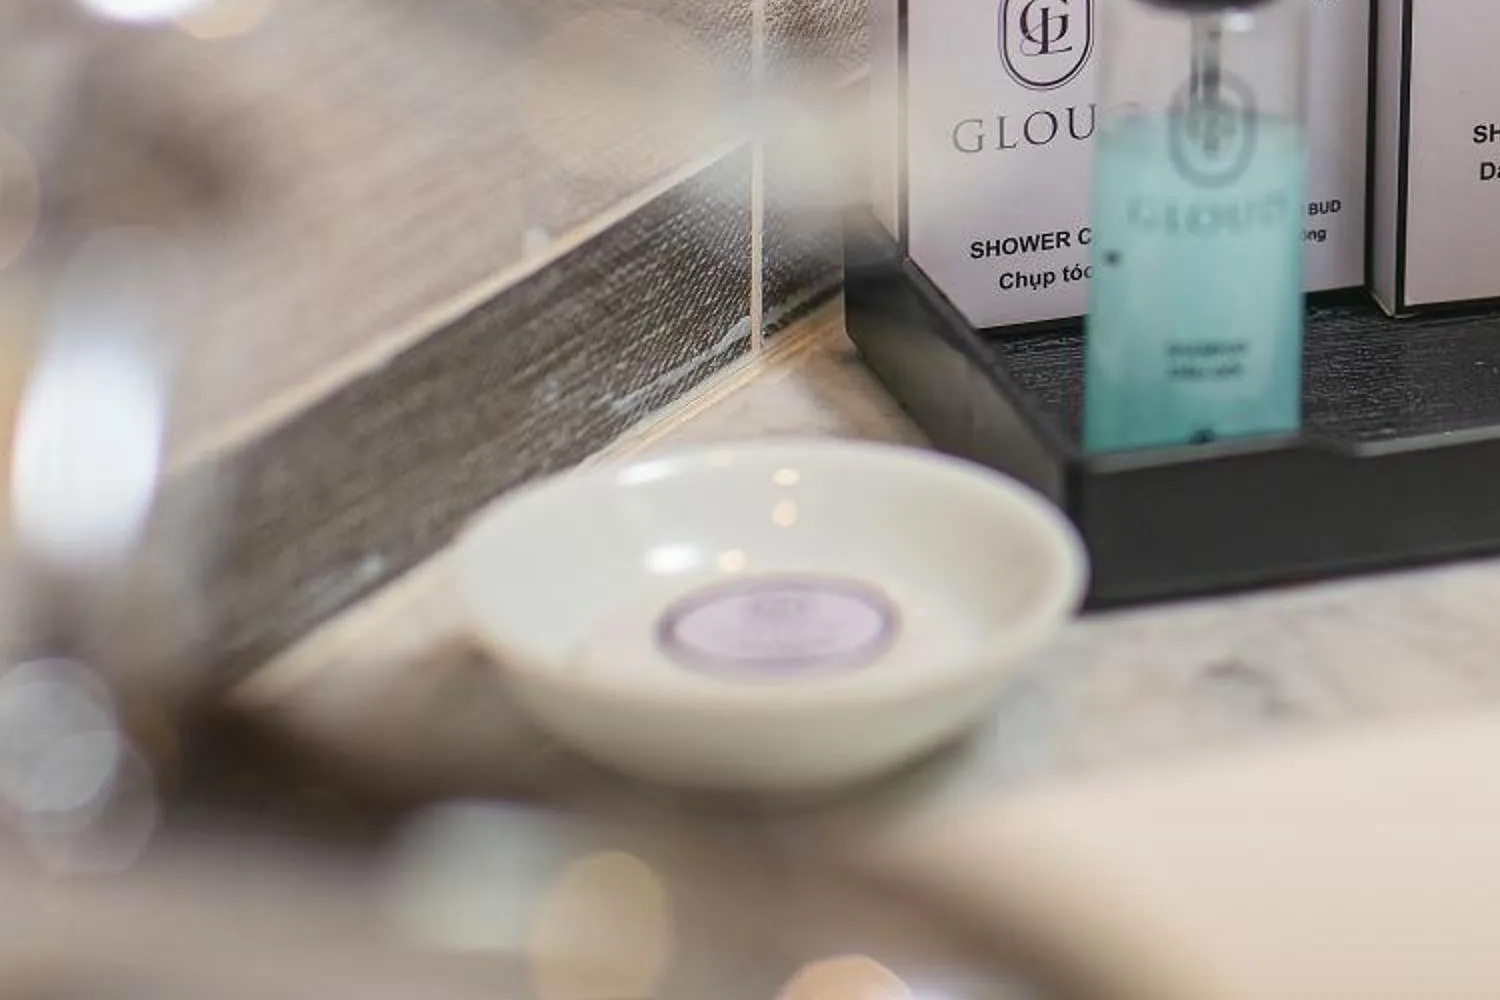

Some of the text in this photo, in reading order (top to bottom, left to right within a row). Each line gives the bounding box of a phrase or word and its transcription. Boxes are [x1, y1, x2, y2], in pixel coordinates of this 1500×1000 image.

[952, 103, 1097, 153] GLOU
[1308, 199, 1341, 216] BUD
[970, 230, 1071, 259] SHOWER
[999, 270, 1056, 290] Chụp
